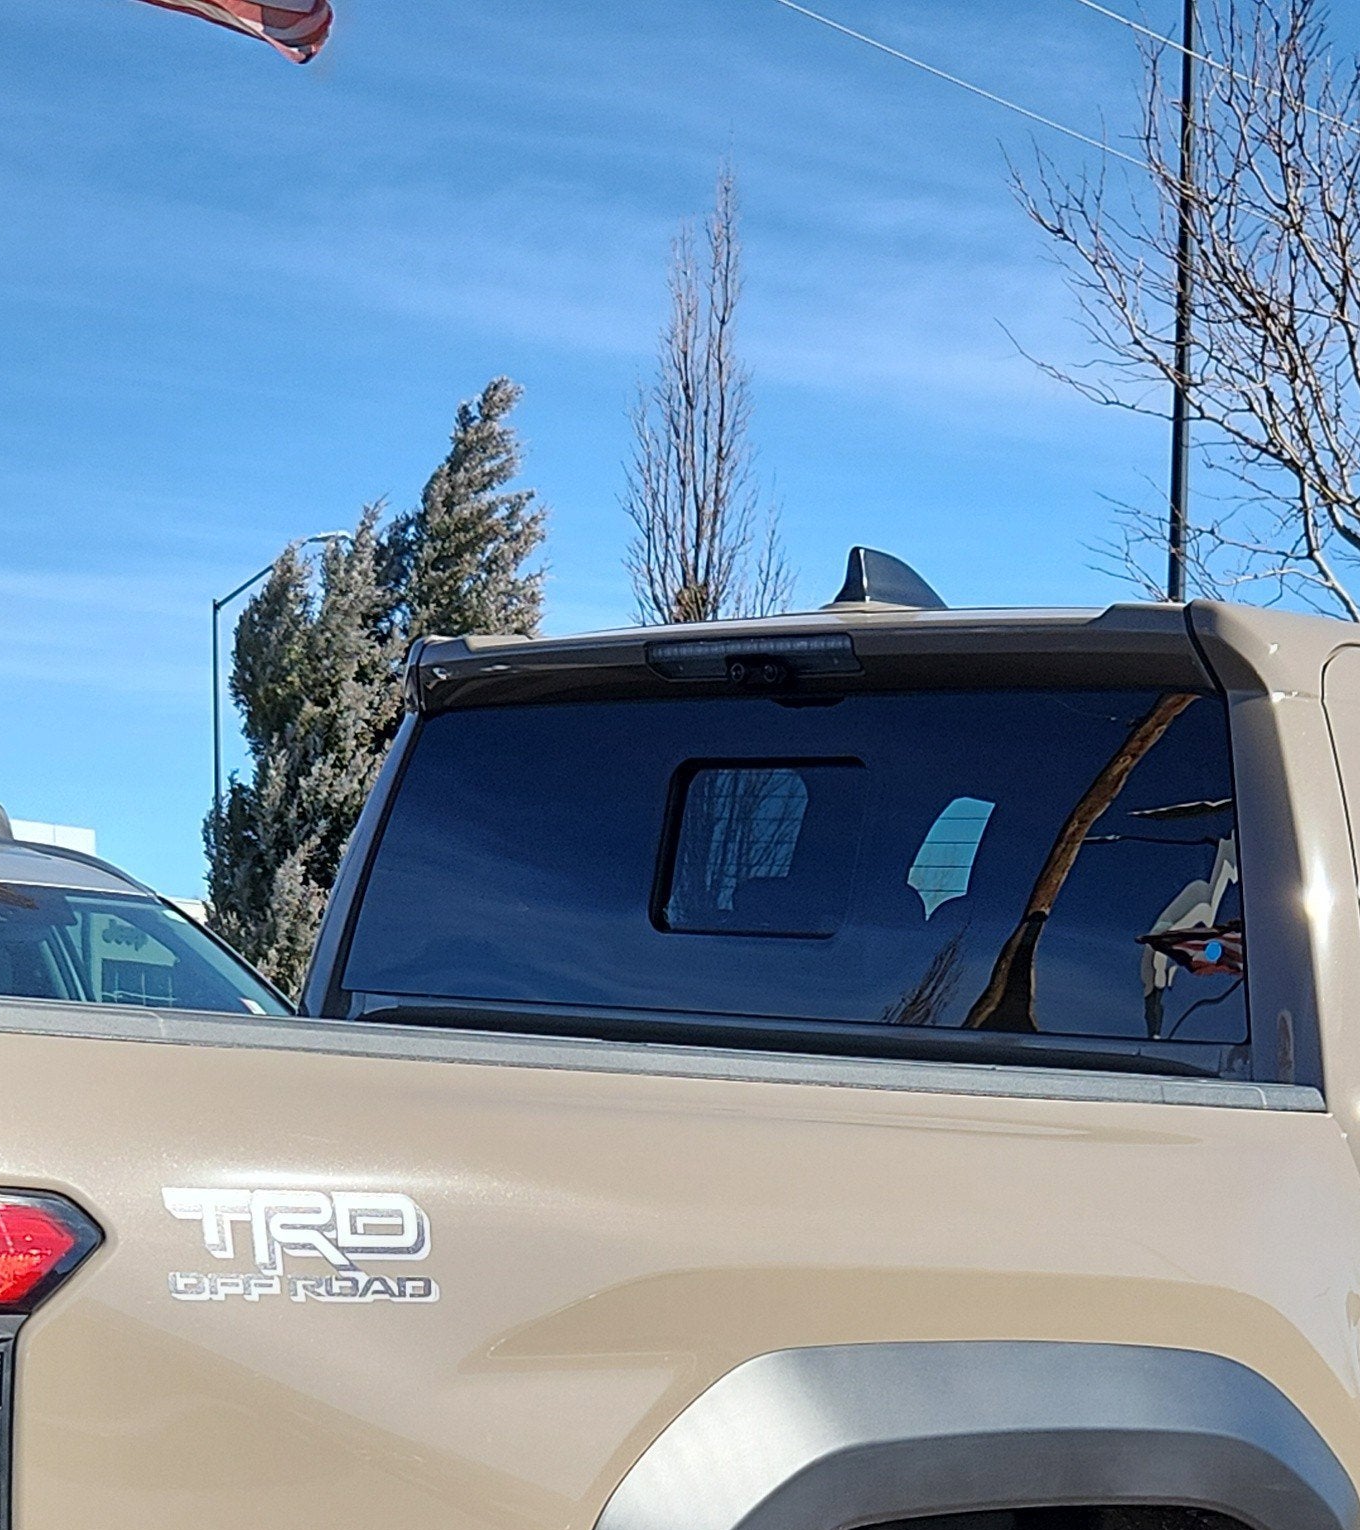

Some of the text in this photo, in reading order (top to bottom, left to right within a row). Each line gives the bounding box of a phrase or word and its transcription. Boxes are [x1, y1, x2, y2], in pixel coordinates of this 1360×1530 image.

[161, 1187, 432, 1276] TRD
[168, 1272, 440, 1303] OFF ROAD
